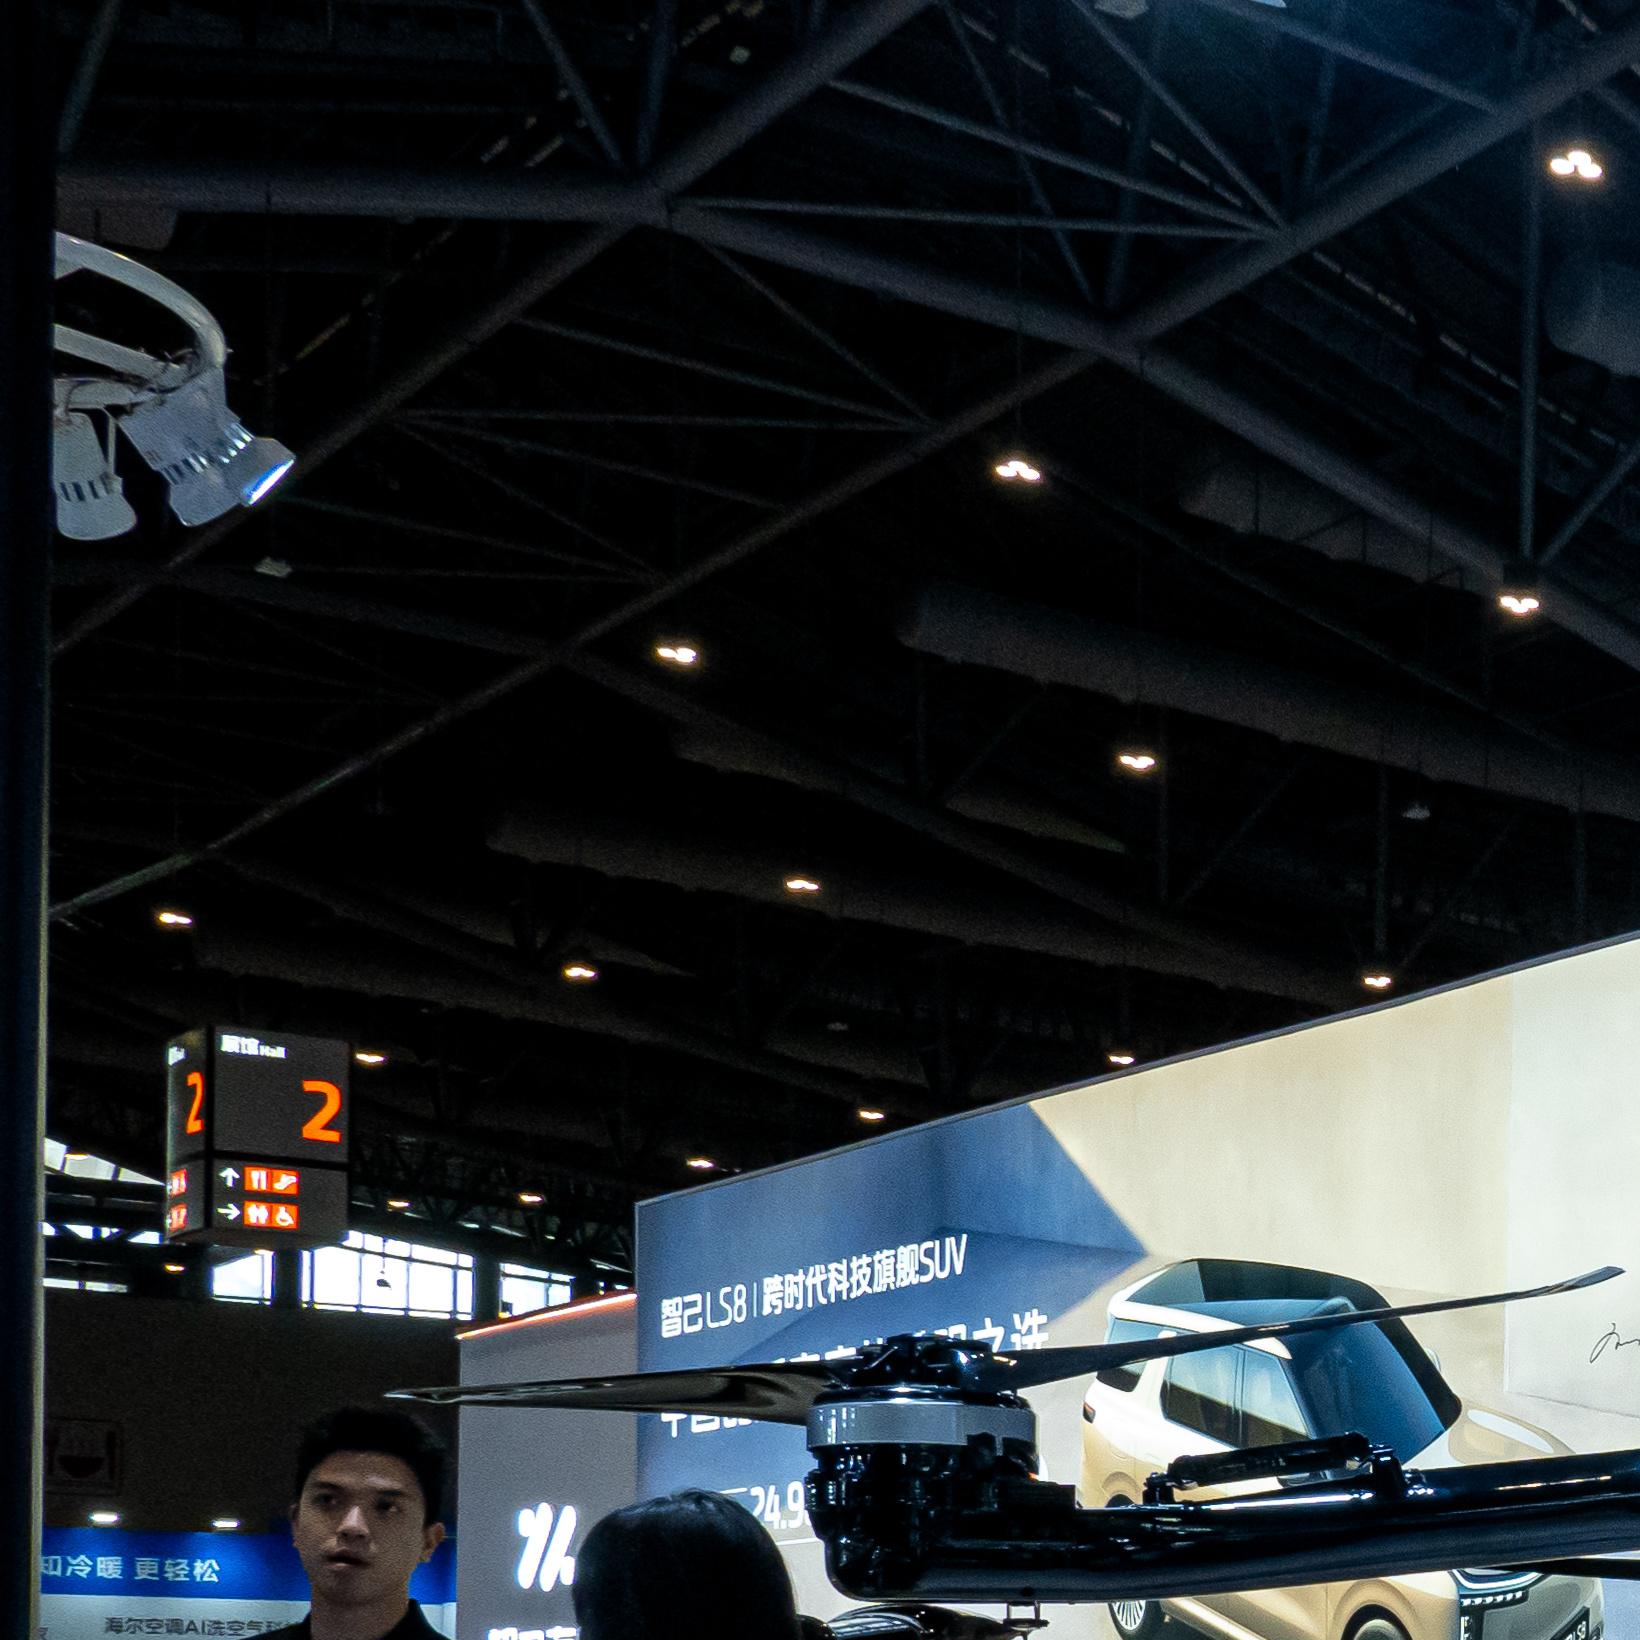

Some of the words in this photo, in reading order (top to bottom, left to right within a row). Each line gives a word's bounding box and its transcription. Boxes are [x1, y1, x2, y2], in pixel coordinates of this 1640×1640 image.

[186, 1071, 204, 1135] 2
[302, 1079, 342, 1144] 2
[762, 1233, 968, 1316] 跨时代科技旗舰SUV
[134, 1557, 220, 1583] 更轻松
[104, 1616, 291, 1637] 海尔空调AI洗空气科
